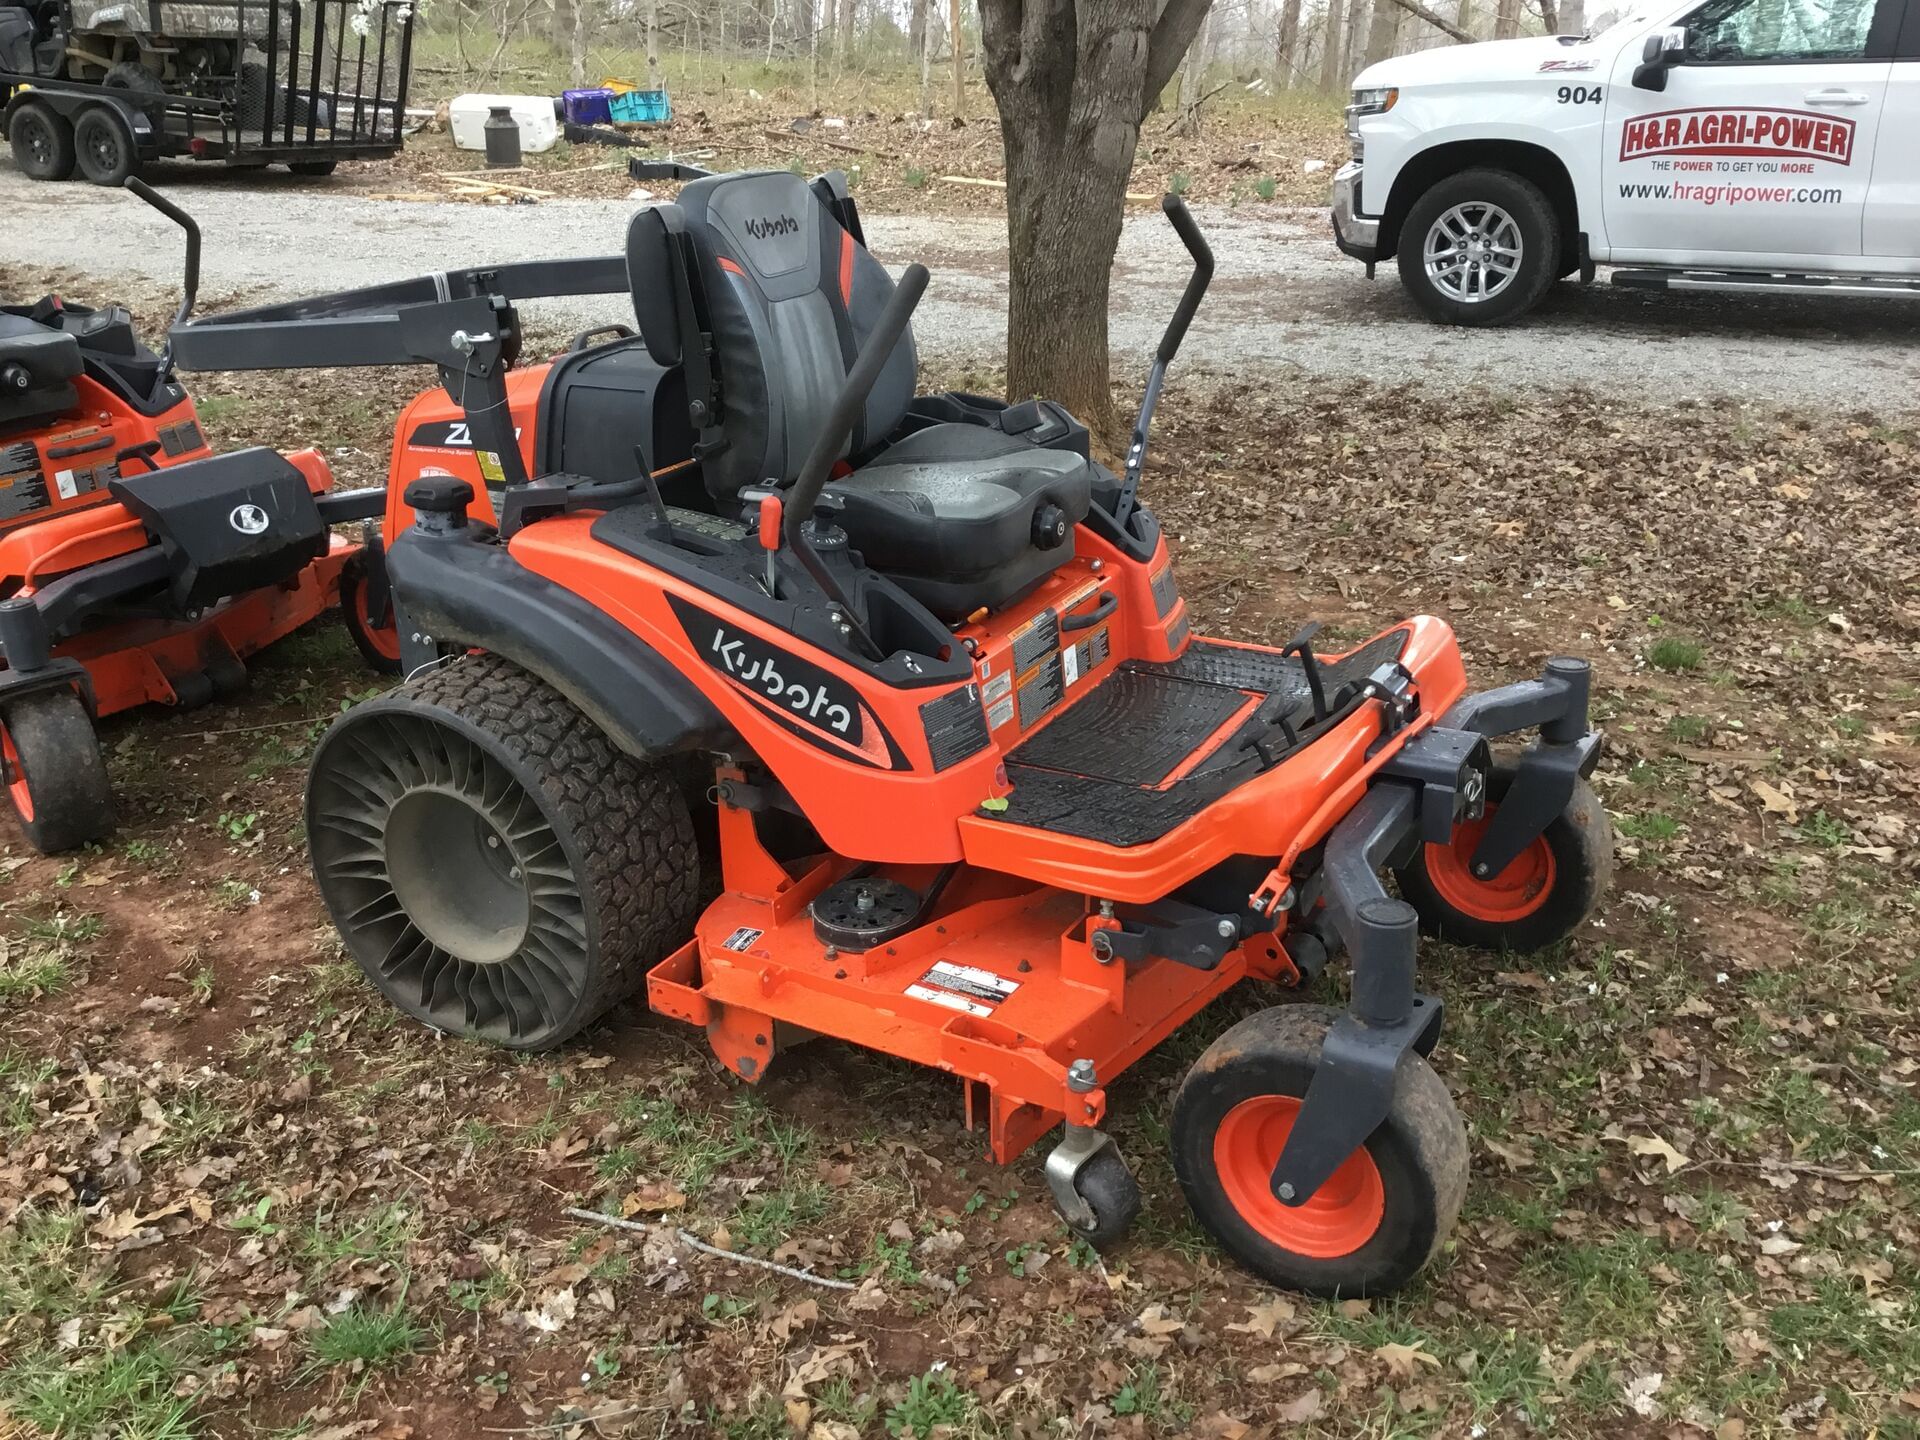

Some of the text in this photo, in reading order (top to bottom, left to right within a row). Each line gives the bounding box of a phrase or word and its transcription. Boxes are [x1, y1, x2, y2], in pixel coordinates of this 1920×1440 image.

[1557, 86, 1602, 104] 904
[1626, 114, 1848, 156] H&R AGRI-POWER
[1651, 161, 1814, 174] THE POWER TO GET YOU MORE
[1619, 181, 1842, 205] www.hragripower.com
[744, 214, 799, 239] Kubota
[712, 628, 851, 732] Kubota
